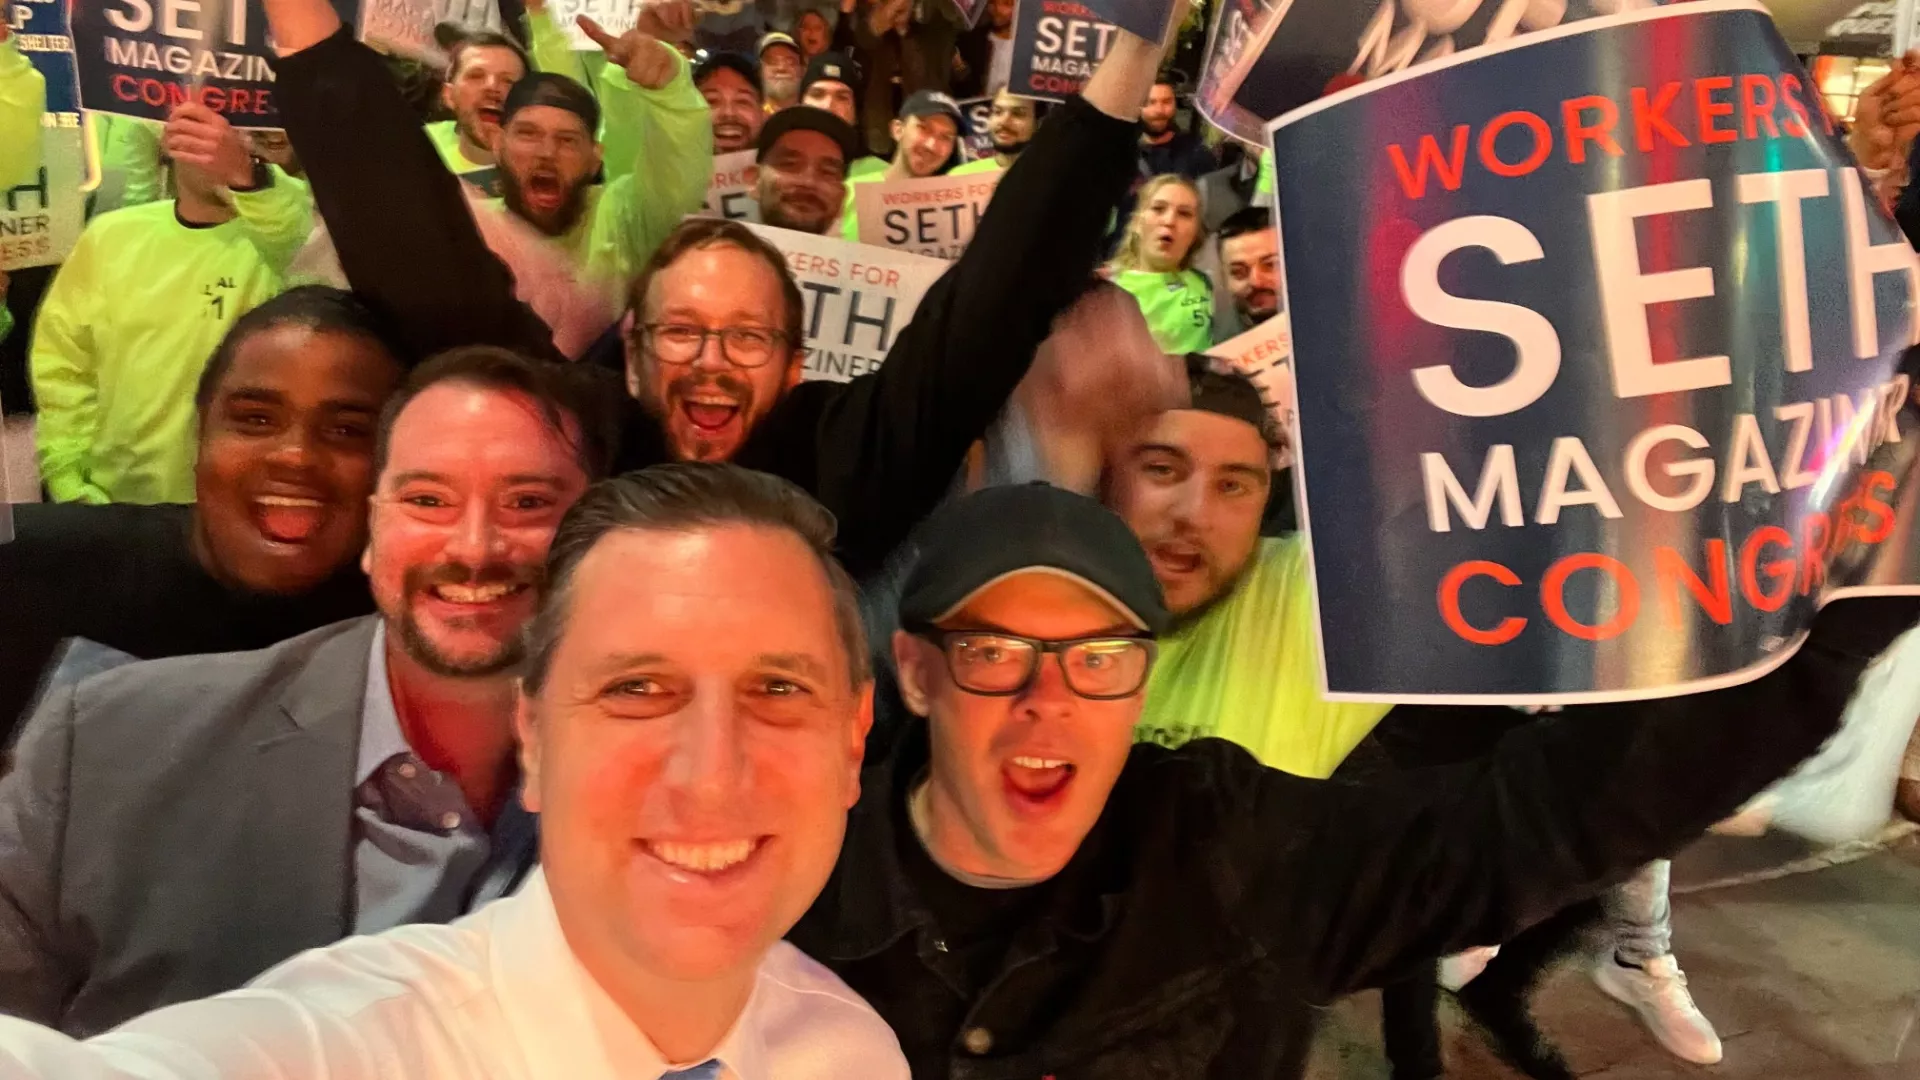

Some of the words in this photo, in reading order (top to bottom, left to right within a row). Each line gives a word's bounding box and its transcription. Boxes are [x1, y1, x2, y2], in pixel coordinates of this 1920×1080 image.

[104, 36, 277, 82] MAGAZIN
[1387, 72, 1810, 199] WORKERS
[851, 263, 900, 289] FOR
[1400, 166, 1920, 418] SETH
[1437, 470, 1896, 645] CONGRS
